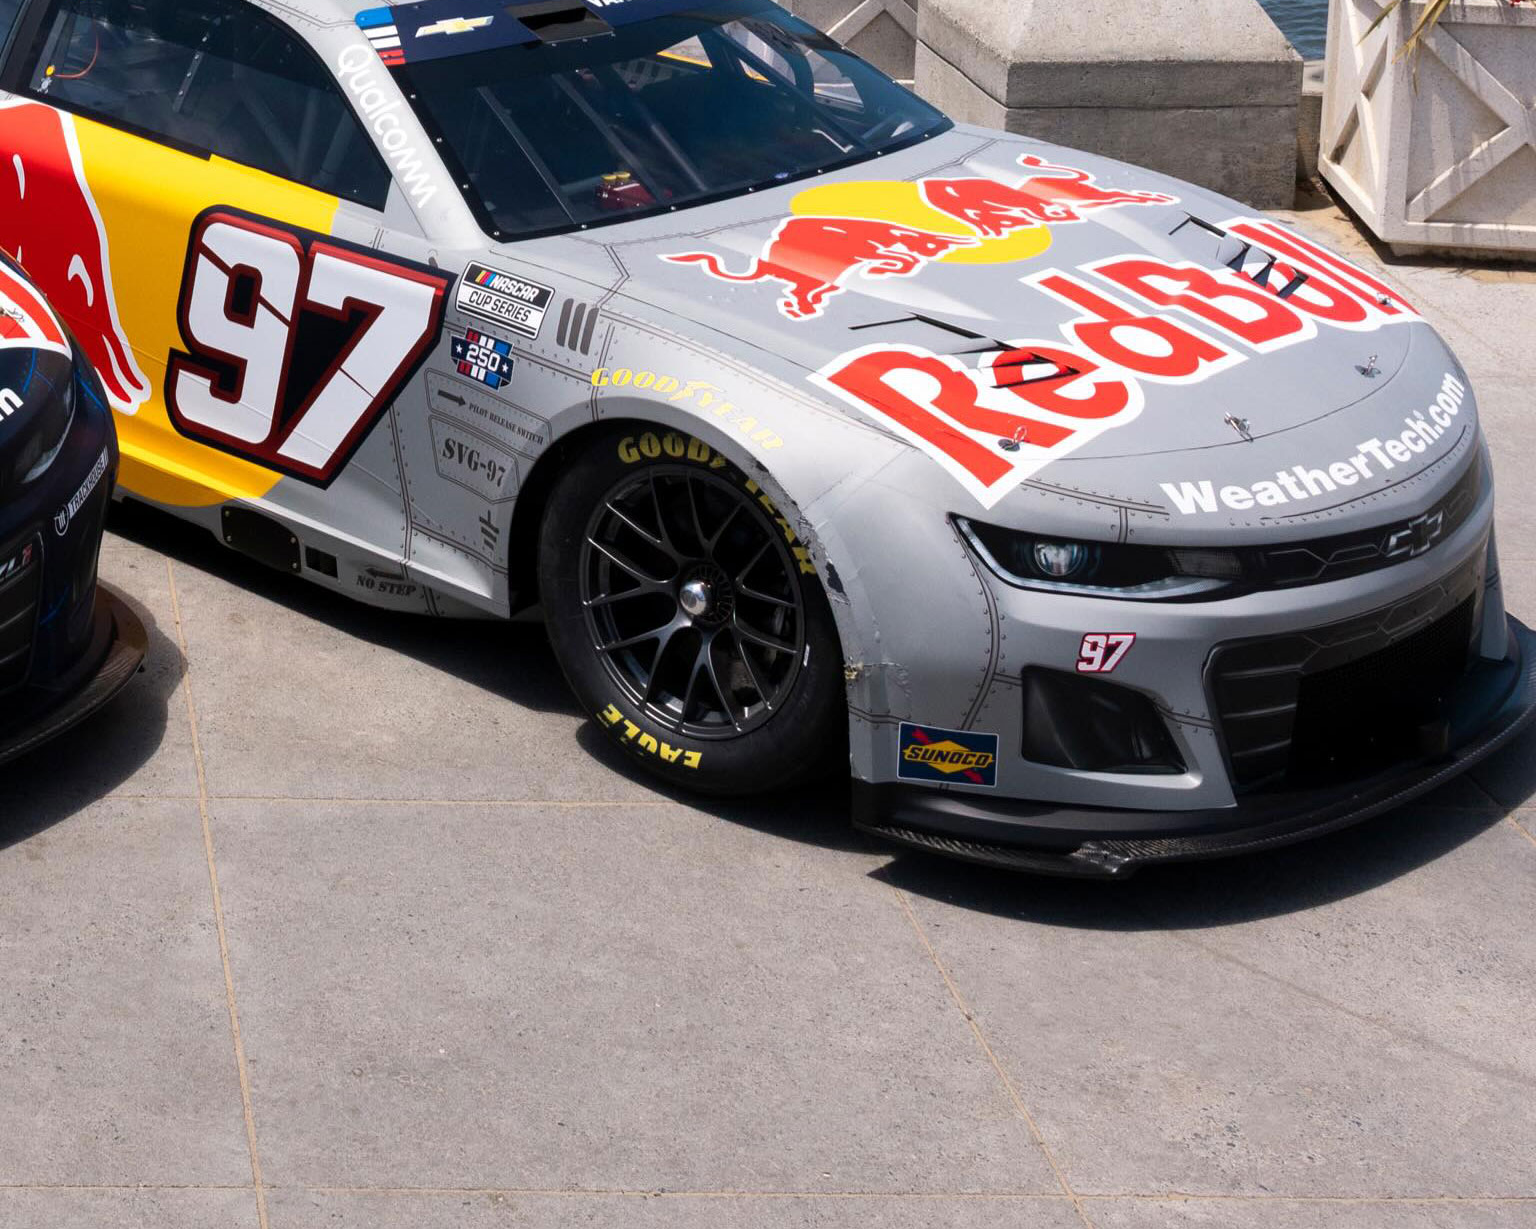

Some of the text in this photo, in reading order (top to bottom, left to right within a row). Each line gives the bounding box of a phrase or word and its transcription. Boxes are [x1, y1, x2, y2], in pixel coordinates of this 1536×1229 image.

[337, 43, 438, 209] Qualcomm
[468, 290, 531, 322] CUP SERIES
[488, 273, 540, 303] NASCAR
[169, 211, 449, 481] 97
[466, 344, 501, 372] 250
[468, 402, 544, 444] PILOT RELEASE SWITCH
[590, 367, 785, 451] GOODYEAR
[442, 437, 506, 488] SVG-97
[356, 575, 417, 597] NO STEP
[1076, 633, 1137, 673] 97
[908, 746, 992, 767] SUNOCO
